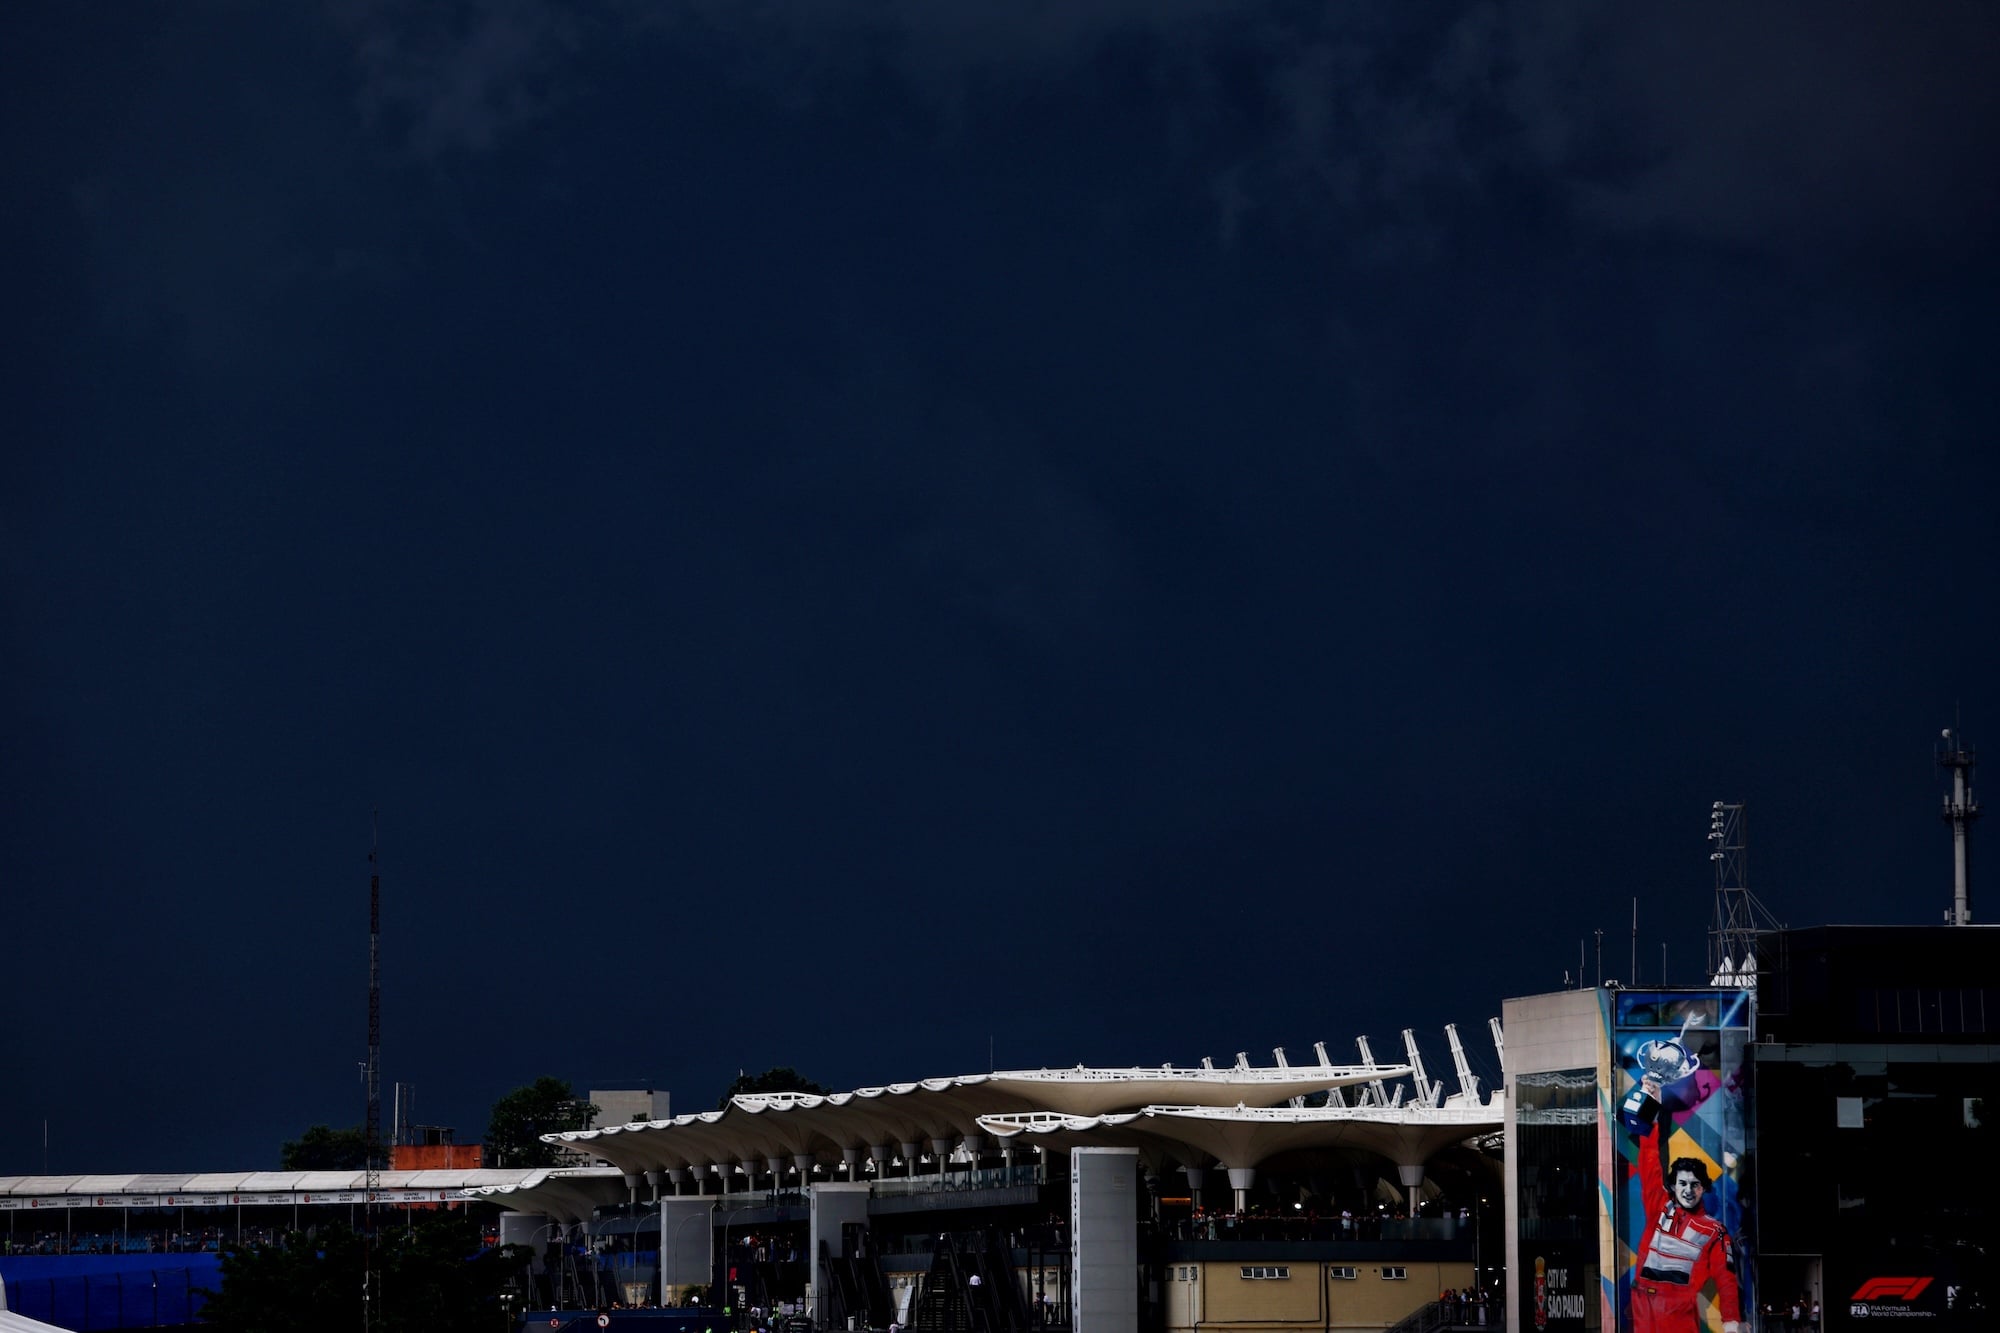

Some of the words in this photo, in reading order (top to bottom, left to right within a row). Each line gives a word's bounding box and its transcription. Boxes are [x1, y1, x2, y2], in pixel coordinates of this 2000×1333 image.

[1547, 1268, 1559, 1288] CITY
[1559, 1268, 1568, 1288] OF
[1547, 1290, 1562, 1318] SÃO
[1562, 1294, 1584, 1318] PAULO
[1851, 1305, 1868, 1315] FIA
